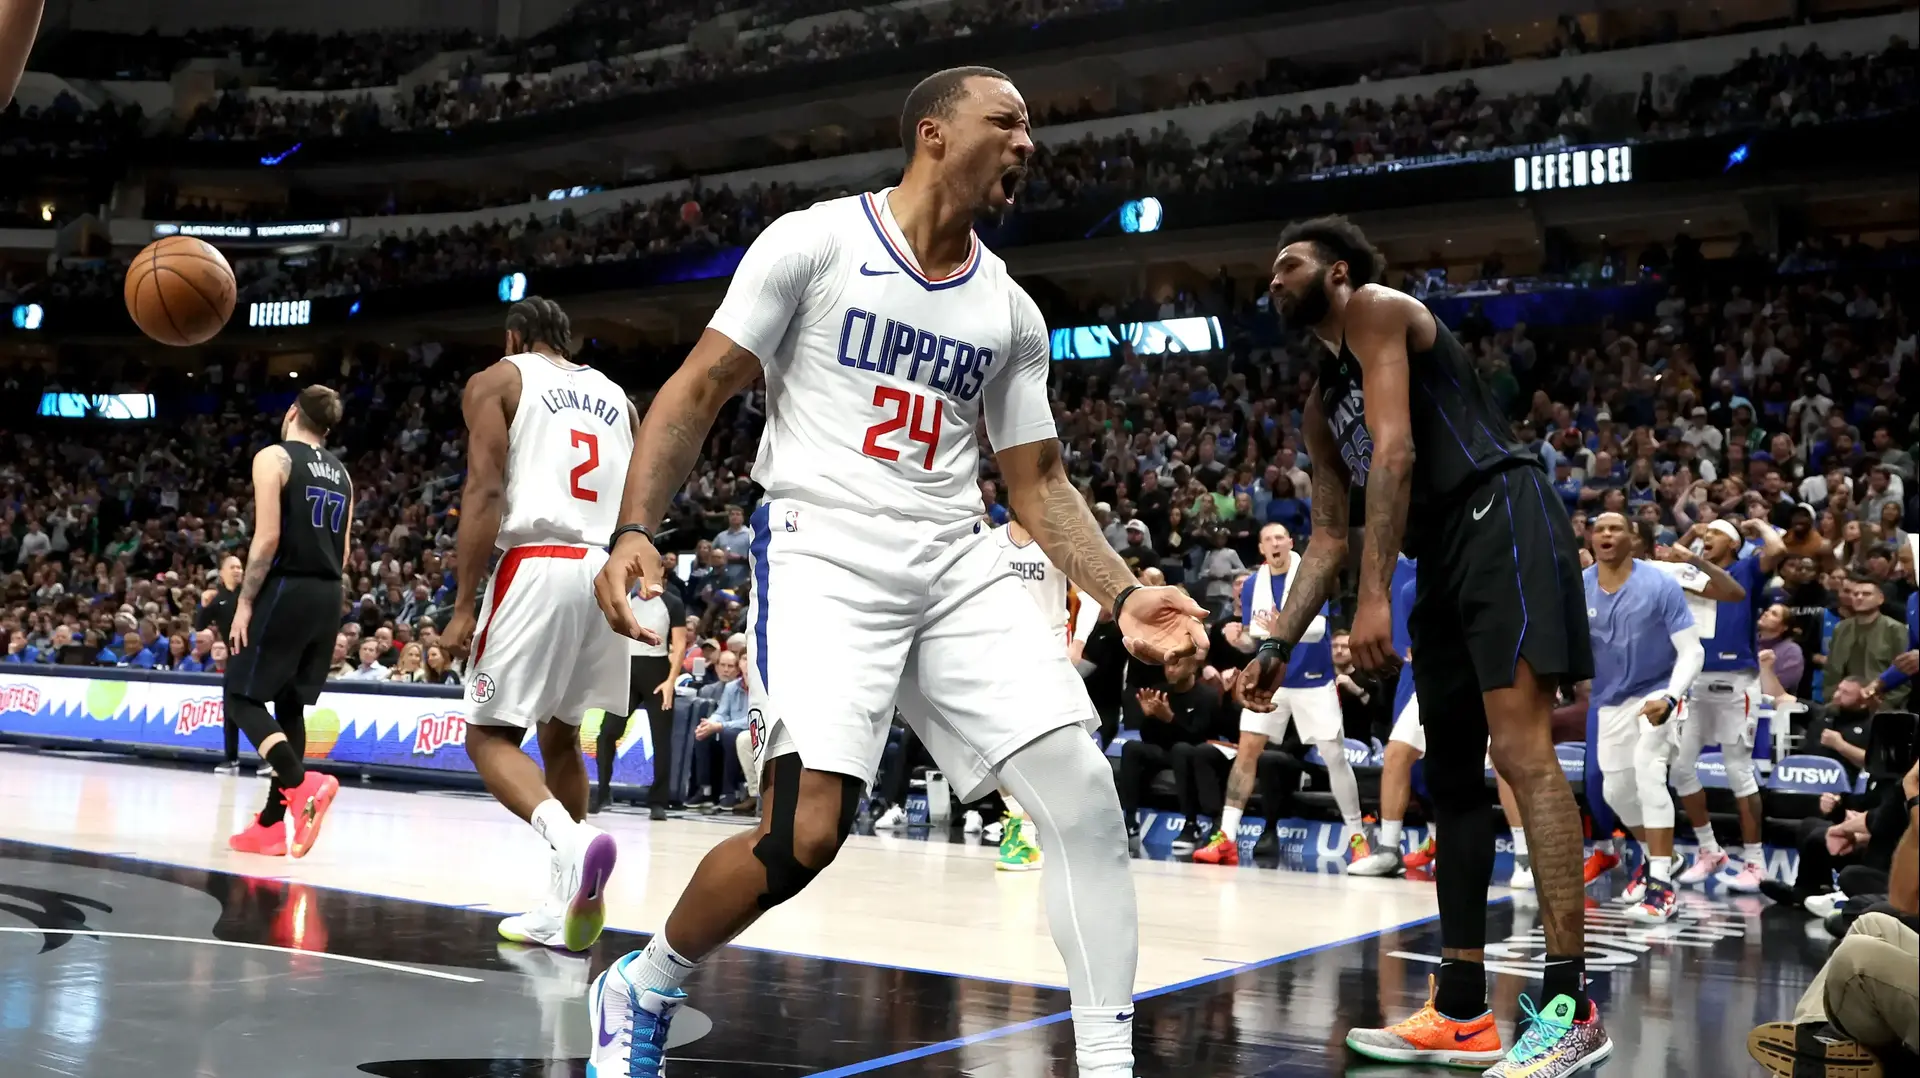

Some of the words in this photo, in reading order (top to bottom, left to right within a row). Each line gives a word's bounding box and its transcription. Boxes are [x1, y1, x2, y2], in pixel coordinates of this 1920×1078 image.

[837, 307, 992, 401] CLIPPERS
[541, 388, 619, 426] LEONARD
[862, 385, 943, 470] 24
[570, 428, 599, 503] 2
[306, 485, 346, 533] 77
[1009, 561, 1045, 581] PERS
[178, 700, 224, 732] RUFFL
[417, 715, 467, 751] RUFF
[1777, 765, 1841, 785] UTSW
